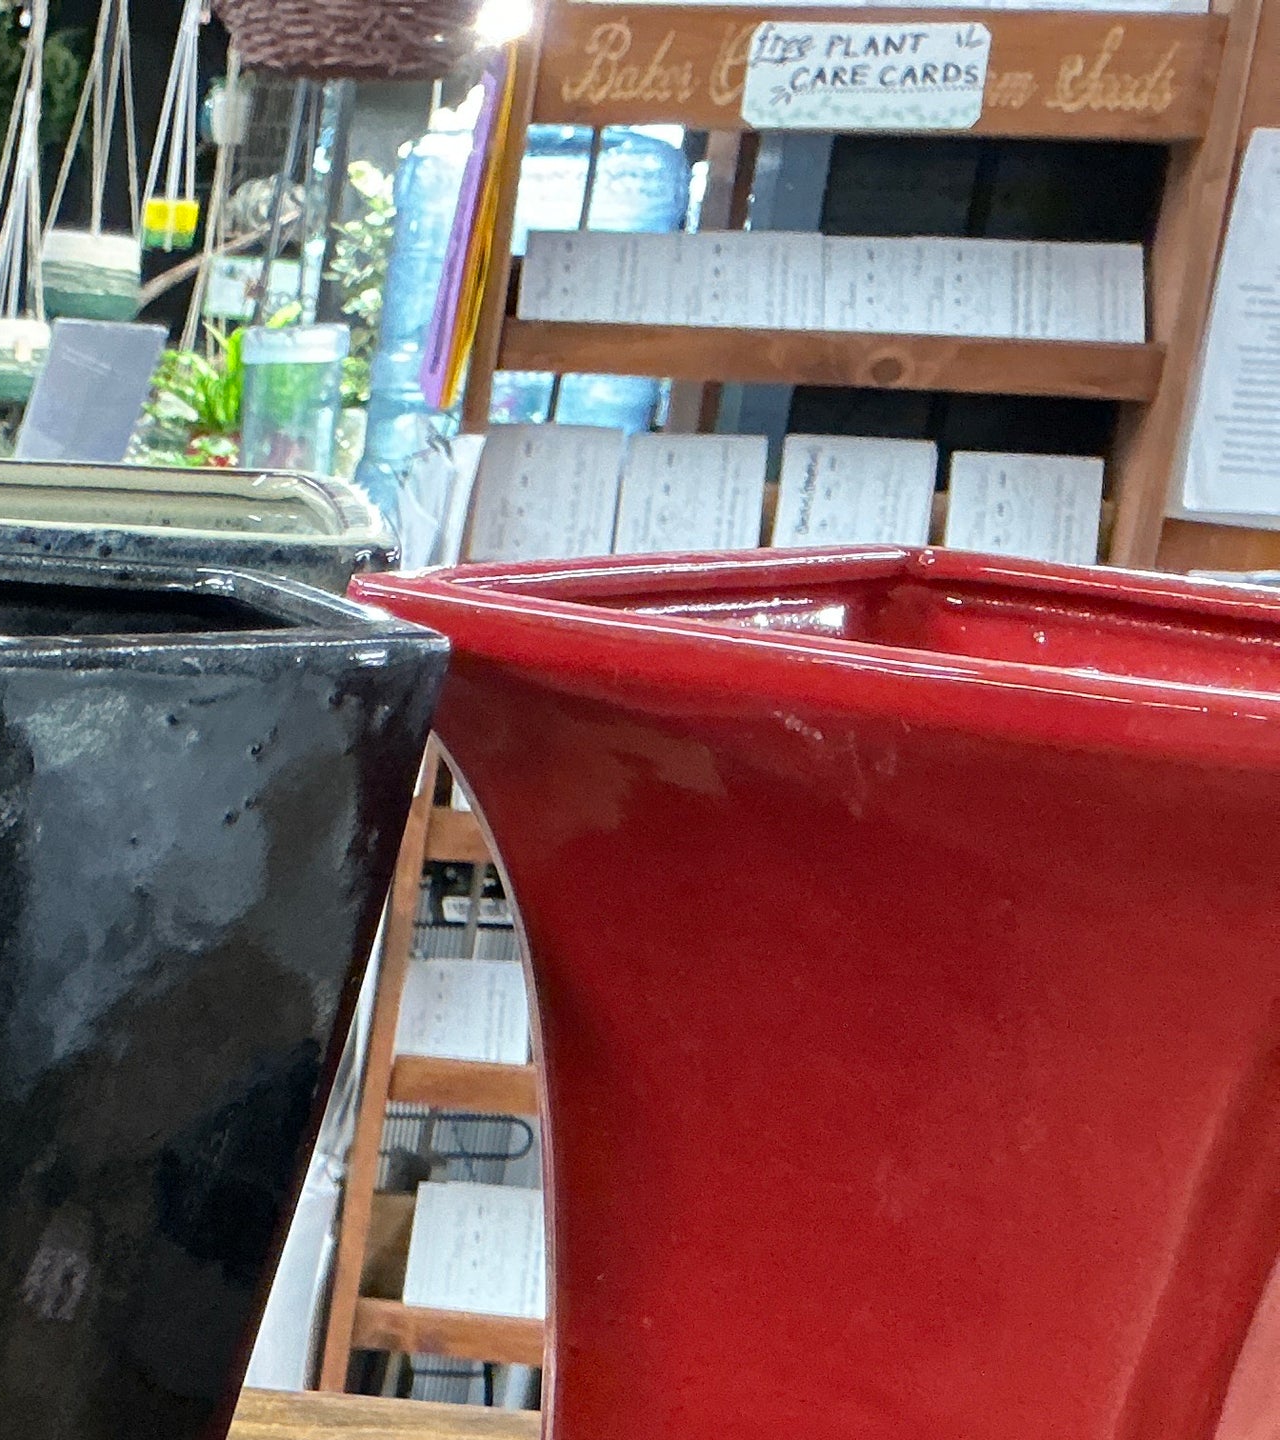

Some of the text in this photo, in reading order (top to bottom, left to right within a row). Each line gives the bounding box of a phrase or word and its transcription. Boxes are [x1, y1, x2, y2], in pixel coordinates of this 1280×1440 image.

[826, 31, 929, 58] PLANT
[790, 62, 980, 91] CARE CARDS
